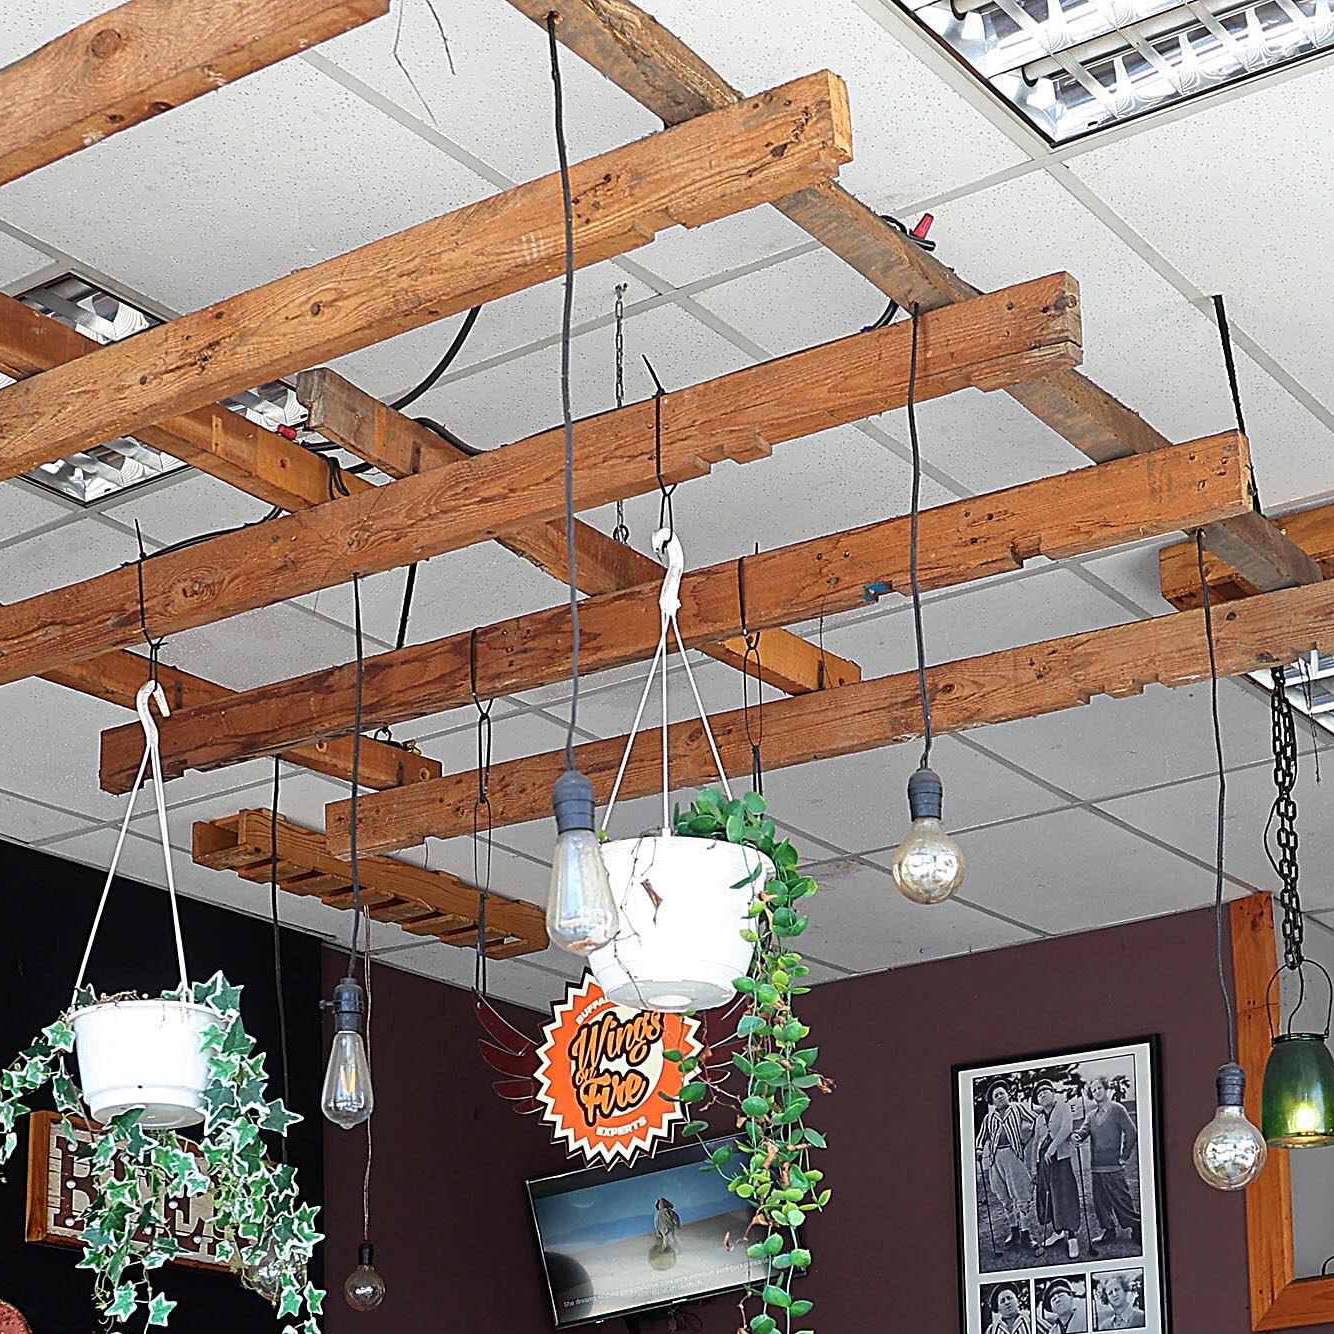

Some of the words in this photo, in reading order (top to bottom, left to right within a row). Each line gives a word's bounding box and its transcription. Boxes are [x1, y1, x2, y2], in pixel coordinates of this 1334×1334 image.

[572, 1012, 661, 1073] Wings
[581, 1073, 646, 1122] Fire
[596, 1116, 648, 1137] EXPERTS
